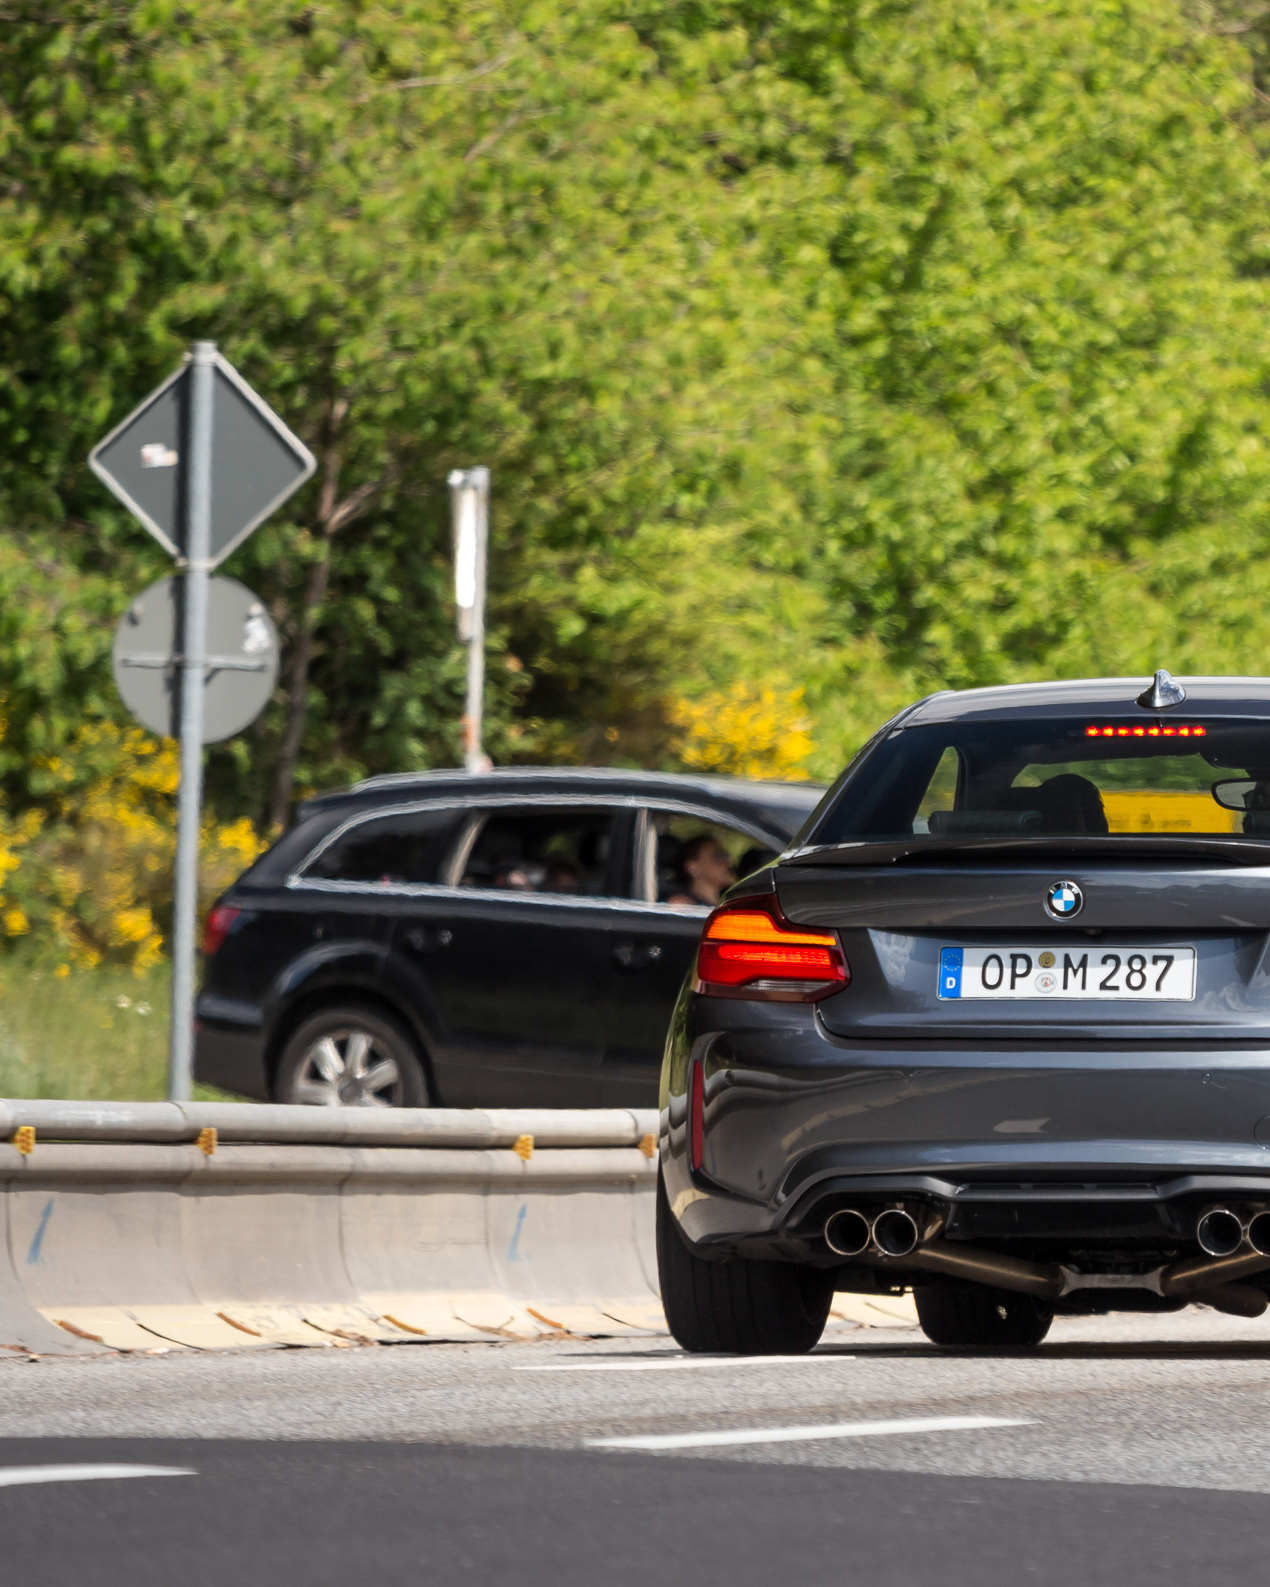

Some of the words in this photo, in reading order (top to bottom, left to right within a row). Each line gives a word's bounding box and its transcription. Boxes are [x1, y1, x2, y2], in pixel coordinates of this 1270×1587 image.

[946, 976, 956, 989] D
[981, 953, 1033, 990] OP
[1062, 953, 1089, 990] M
[1099, 954, 1175, 992] 287
